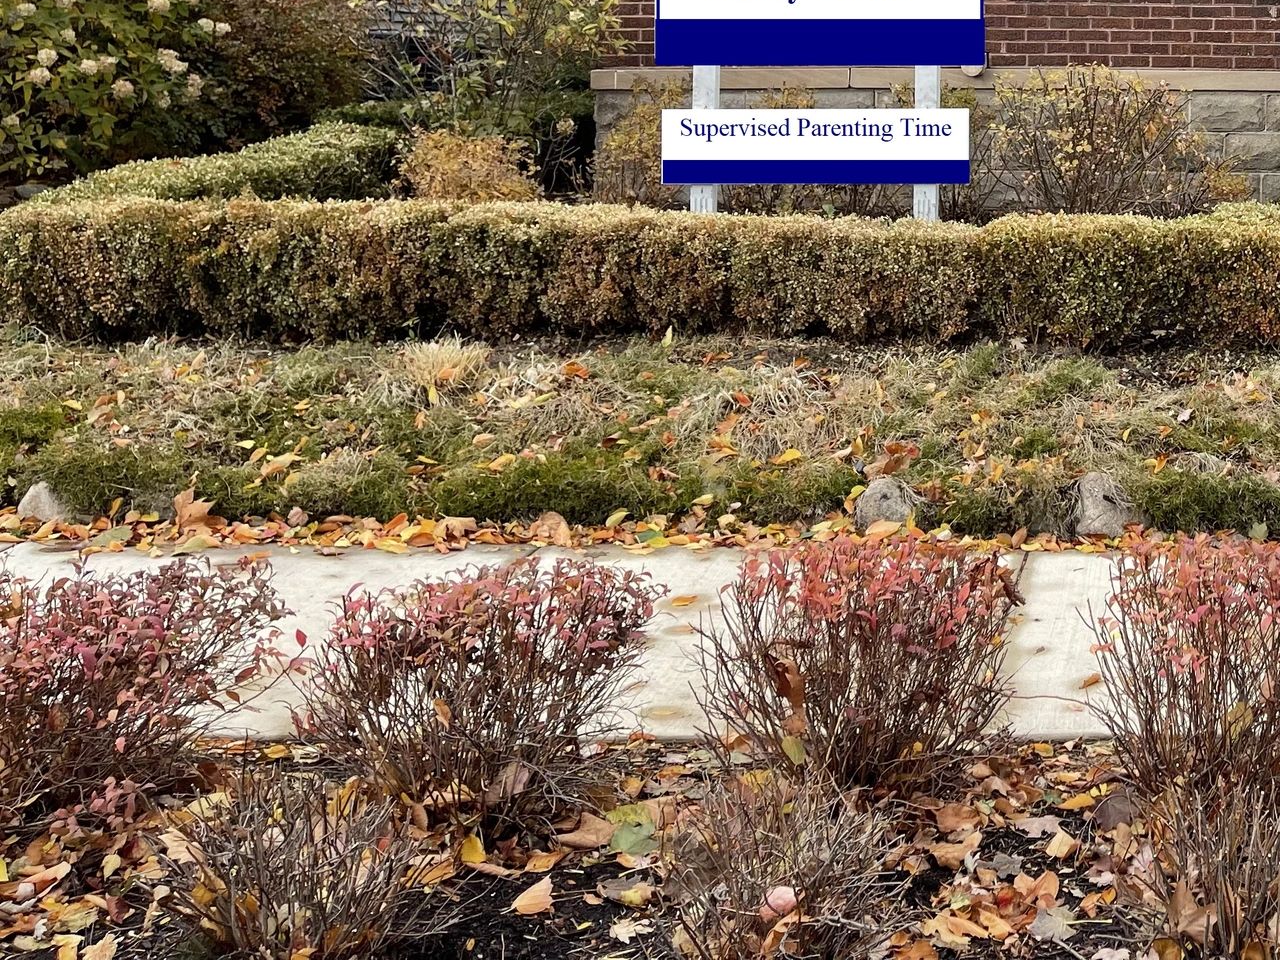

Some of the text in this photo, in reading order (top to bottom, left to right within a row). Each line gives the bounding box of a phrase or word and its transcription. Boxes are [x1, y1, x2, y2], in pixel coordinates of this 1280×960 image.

[680, 117, 952, 142] Supervised Parenting Time
